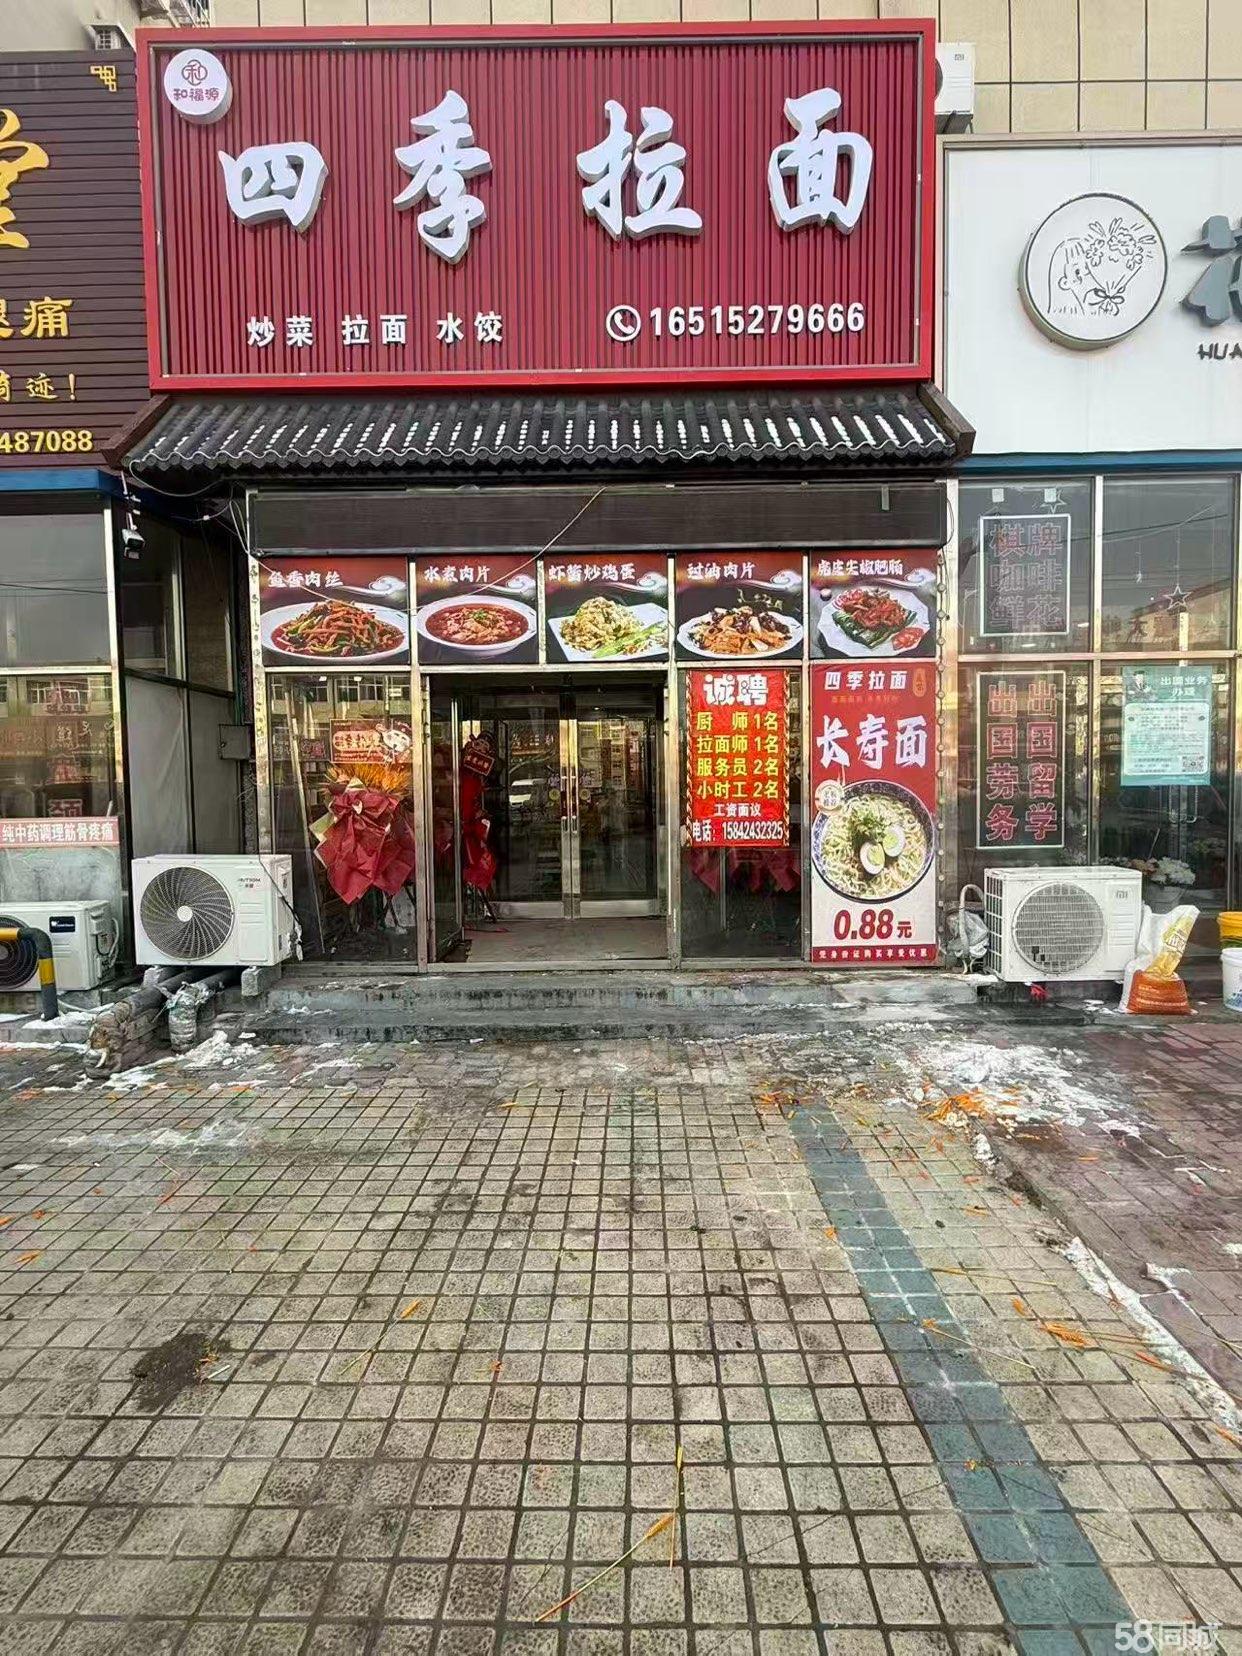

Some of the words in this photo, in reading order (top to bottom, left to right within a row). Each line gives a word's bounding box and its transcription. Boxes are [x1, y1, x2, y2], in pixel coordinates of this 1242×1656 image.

[173, 87, 220, 101] 和福源
[217, 87, 874, 265] 四季拉面
[247, 315, 314, 347] 炒菜
[341, 314, 408, 345] 拉面
[436, 311, 504, 344] 水饺
[650, 302, 865, 336] 16515279666
[989, 521, 1063, 557] 棋牌
[268, 570, 344, 588] 鱼香肉丝
[423, 565, 491, 584] 水煮肉片
[548, 563, 636, 582] 虾酱炒鸡蛋
[687, 562, 756, 581] 过油肉片
[703, 673, 769, 706] 诚聘
[824, 670, 908, 691] 四季拉面
[816, 713, 928, 770] 长寿面
[985, 680, 1019, 842] 出国劳务
[1025, 679, 1058, 841] 出国留学
[714, 803, 761, 818] 工资面议
[2, 822, 115, 843] 纯中药调理筋骨疼痛
[833, 908, 913, 940] 0.88元
